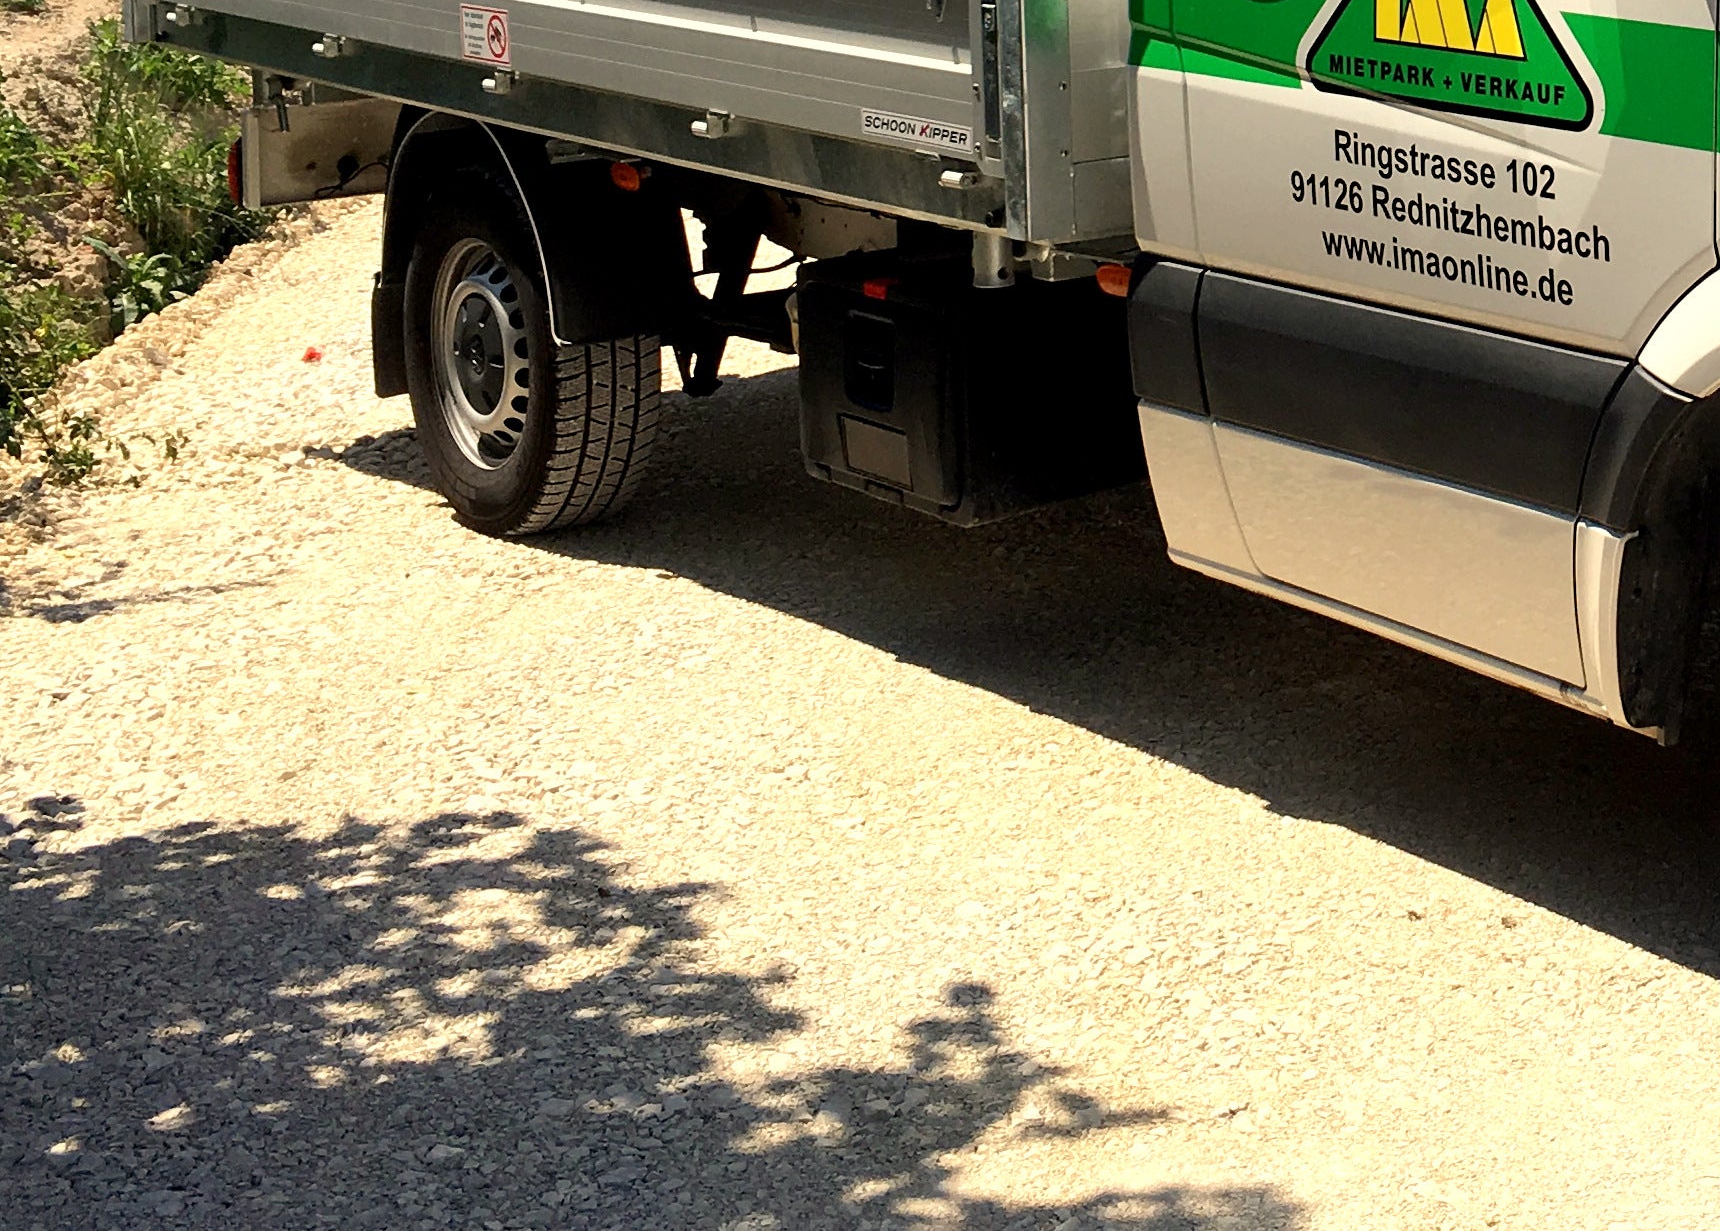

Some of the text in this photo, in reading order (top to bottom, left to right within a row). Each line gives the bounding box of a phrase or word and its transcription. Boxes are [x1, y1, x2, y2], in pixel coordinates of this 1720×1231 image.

[1329, 54, 1435, 87] MIETPARK
[1461, 72, 1566, 106] VERKAUF
[865, 115, 968, 145] SCHOON KIPPER
[1334, 129, 1556, 200] Ringstrasse 102
[1290, 170, 1611, 262] 91126 Rednitzhembach
[1321, 230, 1574, 306] www.imaonline.de
